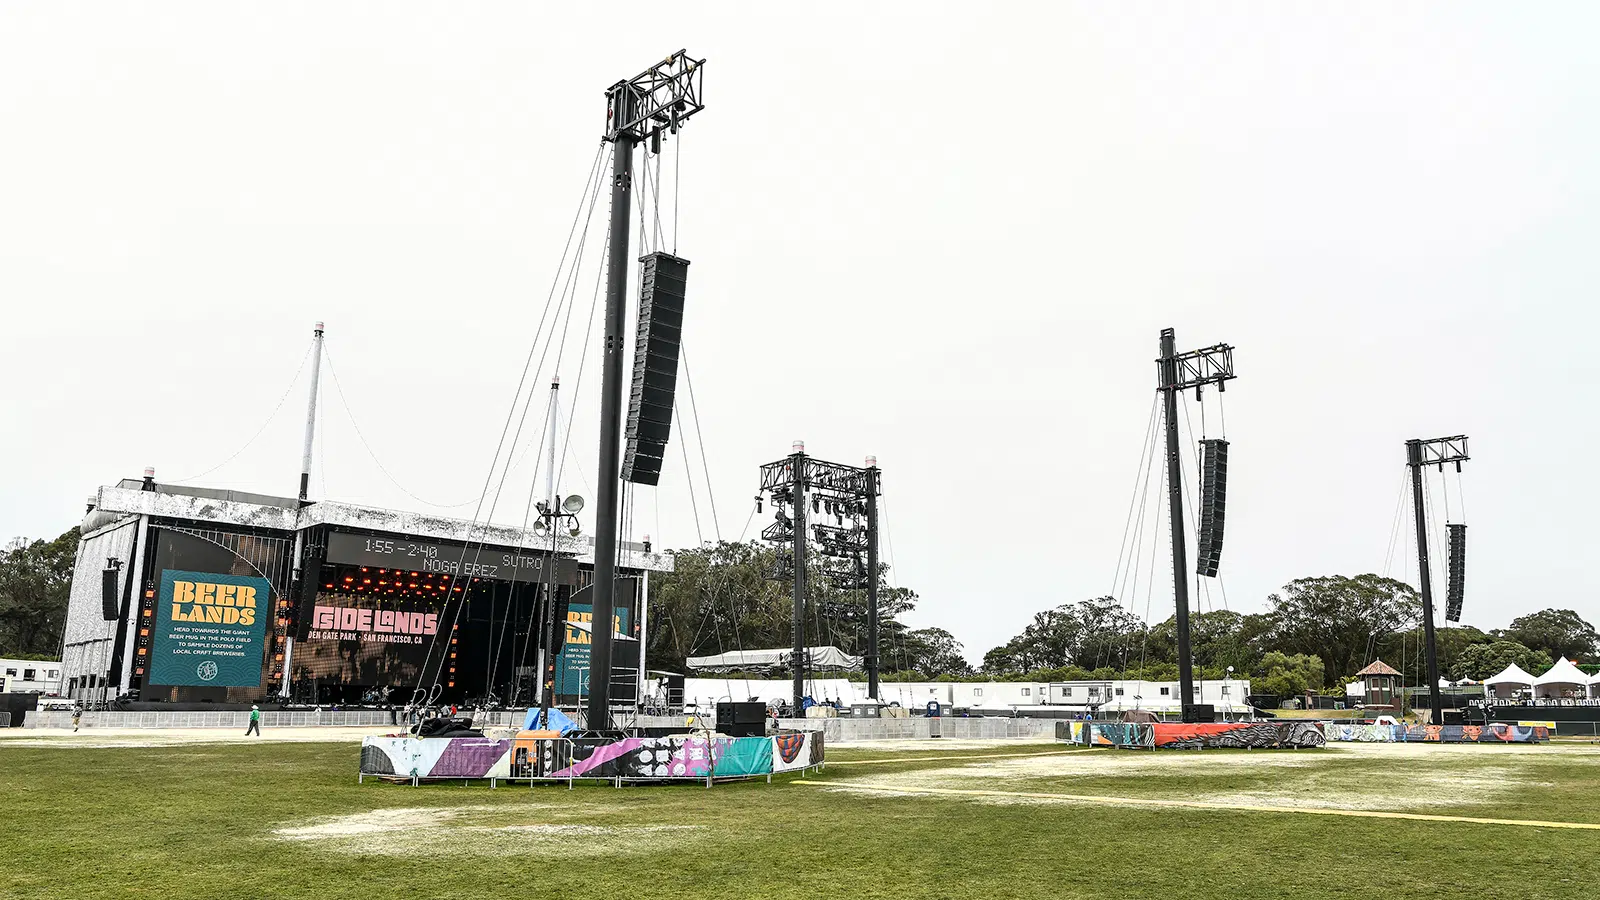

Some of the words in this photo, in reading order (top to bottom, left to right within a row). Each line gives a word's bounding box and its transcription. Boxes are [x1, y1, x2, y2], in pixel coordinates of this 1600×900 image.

[423, 558, 459, 574] NOGA
[464, 562, 498, 578] EREZ
[502, 555, 543, 570] SUTRO
[173, 580, 257, 608] BEER
[171, 603, 257, 626] LANDS
[322, 632, 338, 640] GATE
[340, 633, 357, 641] PARK
[363, 634, 376, 642] SAN
[414, 636, 423, 644] CA
